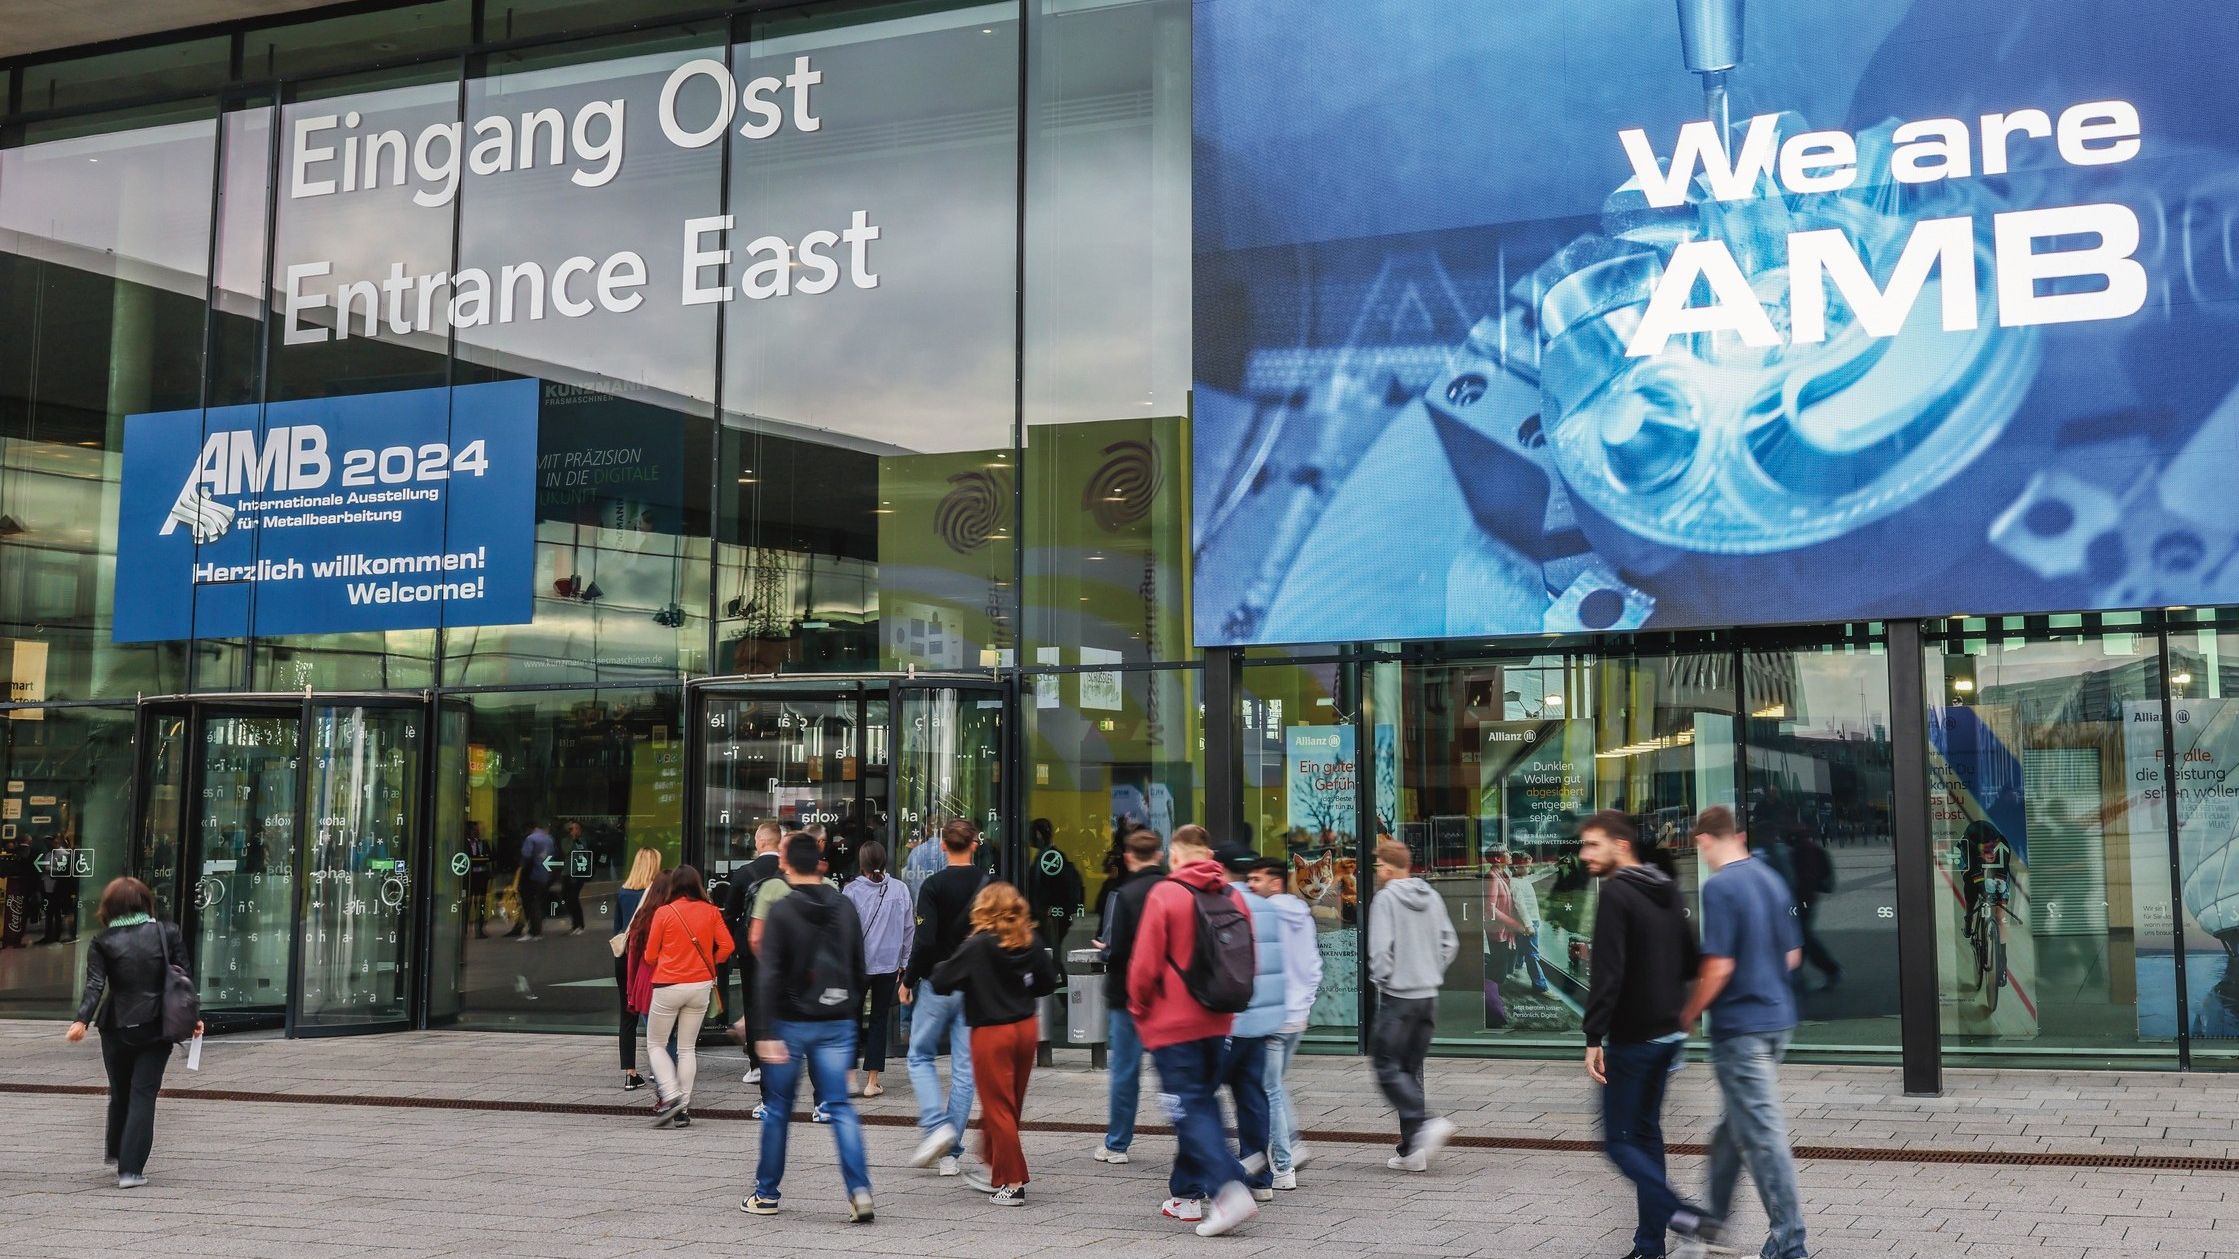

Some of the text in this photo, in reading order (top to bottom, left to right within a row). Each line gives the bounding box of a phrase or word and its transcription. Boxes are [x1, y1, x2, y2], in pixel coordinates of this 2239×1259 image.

[292, 56, 822, 208] Eingang Ost
[1618, 99, 2142, 208] We are
[284, 210, 880, 346] Entrance East
[1625, 203, 2148, 357] AMB
[564, 447, 642, 468] PRÄZISION
[159, 424, 489, 536] AMB 2024
[545, 465, 660, 487] IN DIE DIGITALE
[238, 487, 439, 512] Internationale Ausstellung
[538, 487, 600, 506] UKUNFT
[237, 508, 402, 530] für Metallbearbeitung
[192, 546, 486, 584] Herzlich willkommen!
[347, 576, 485, 605] Welcome!
[2134, 712, 2165, 723] Allia
[1296, 737, 1327, 746] Allianz
[1488, 732, 1522, 742] Allianz
[2155, 748, 2214, 764] Fr alle,
[1300, 761, 1319, 773] Ein
[1533, 761, 1574, 771] Dunklen
[1524, 775, 1581, 785] Wolken gut
[2135, 767, 2226, 782] die eistung
[1315, 778, 1355, 791] Gefüh
[1526, 787, 1584, 798] abgesichert
[1946, 795, 1965, 805] Du
[1531, 801, 1582, 811] entgegen-
[1529, 812, 1562, 822] sehen.
[1931, 810, 1966, 820] iebst.
